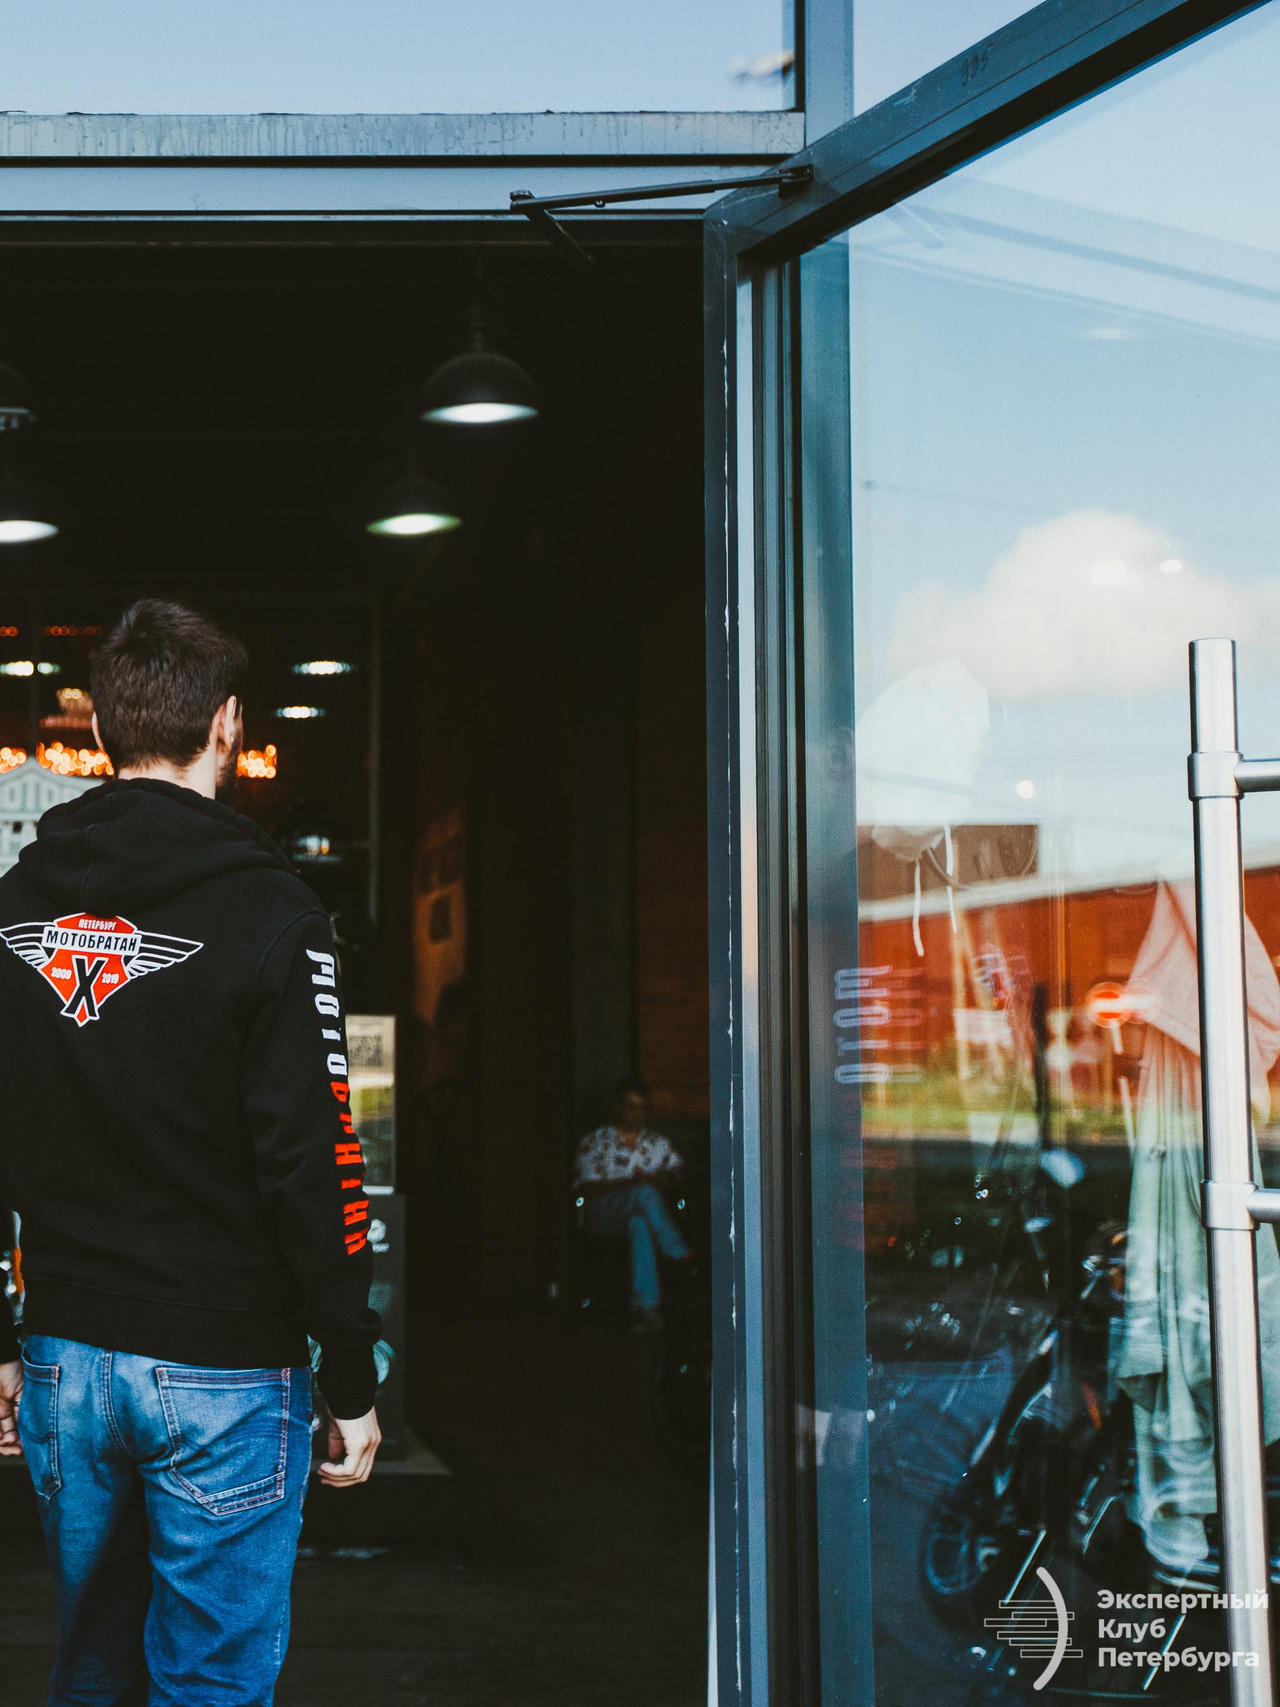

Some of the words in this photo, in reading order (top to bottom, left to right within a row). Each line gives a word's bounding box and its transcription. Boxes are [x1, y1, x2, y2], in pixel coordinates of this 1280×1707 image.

[78, 918, 117, 931] ПЕТЕРБУРГ
[46, 930, 138, 952] МОТОБРАТАН
[101, 972, 120, 985] 2019
